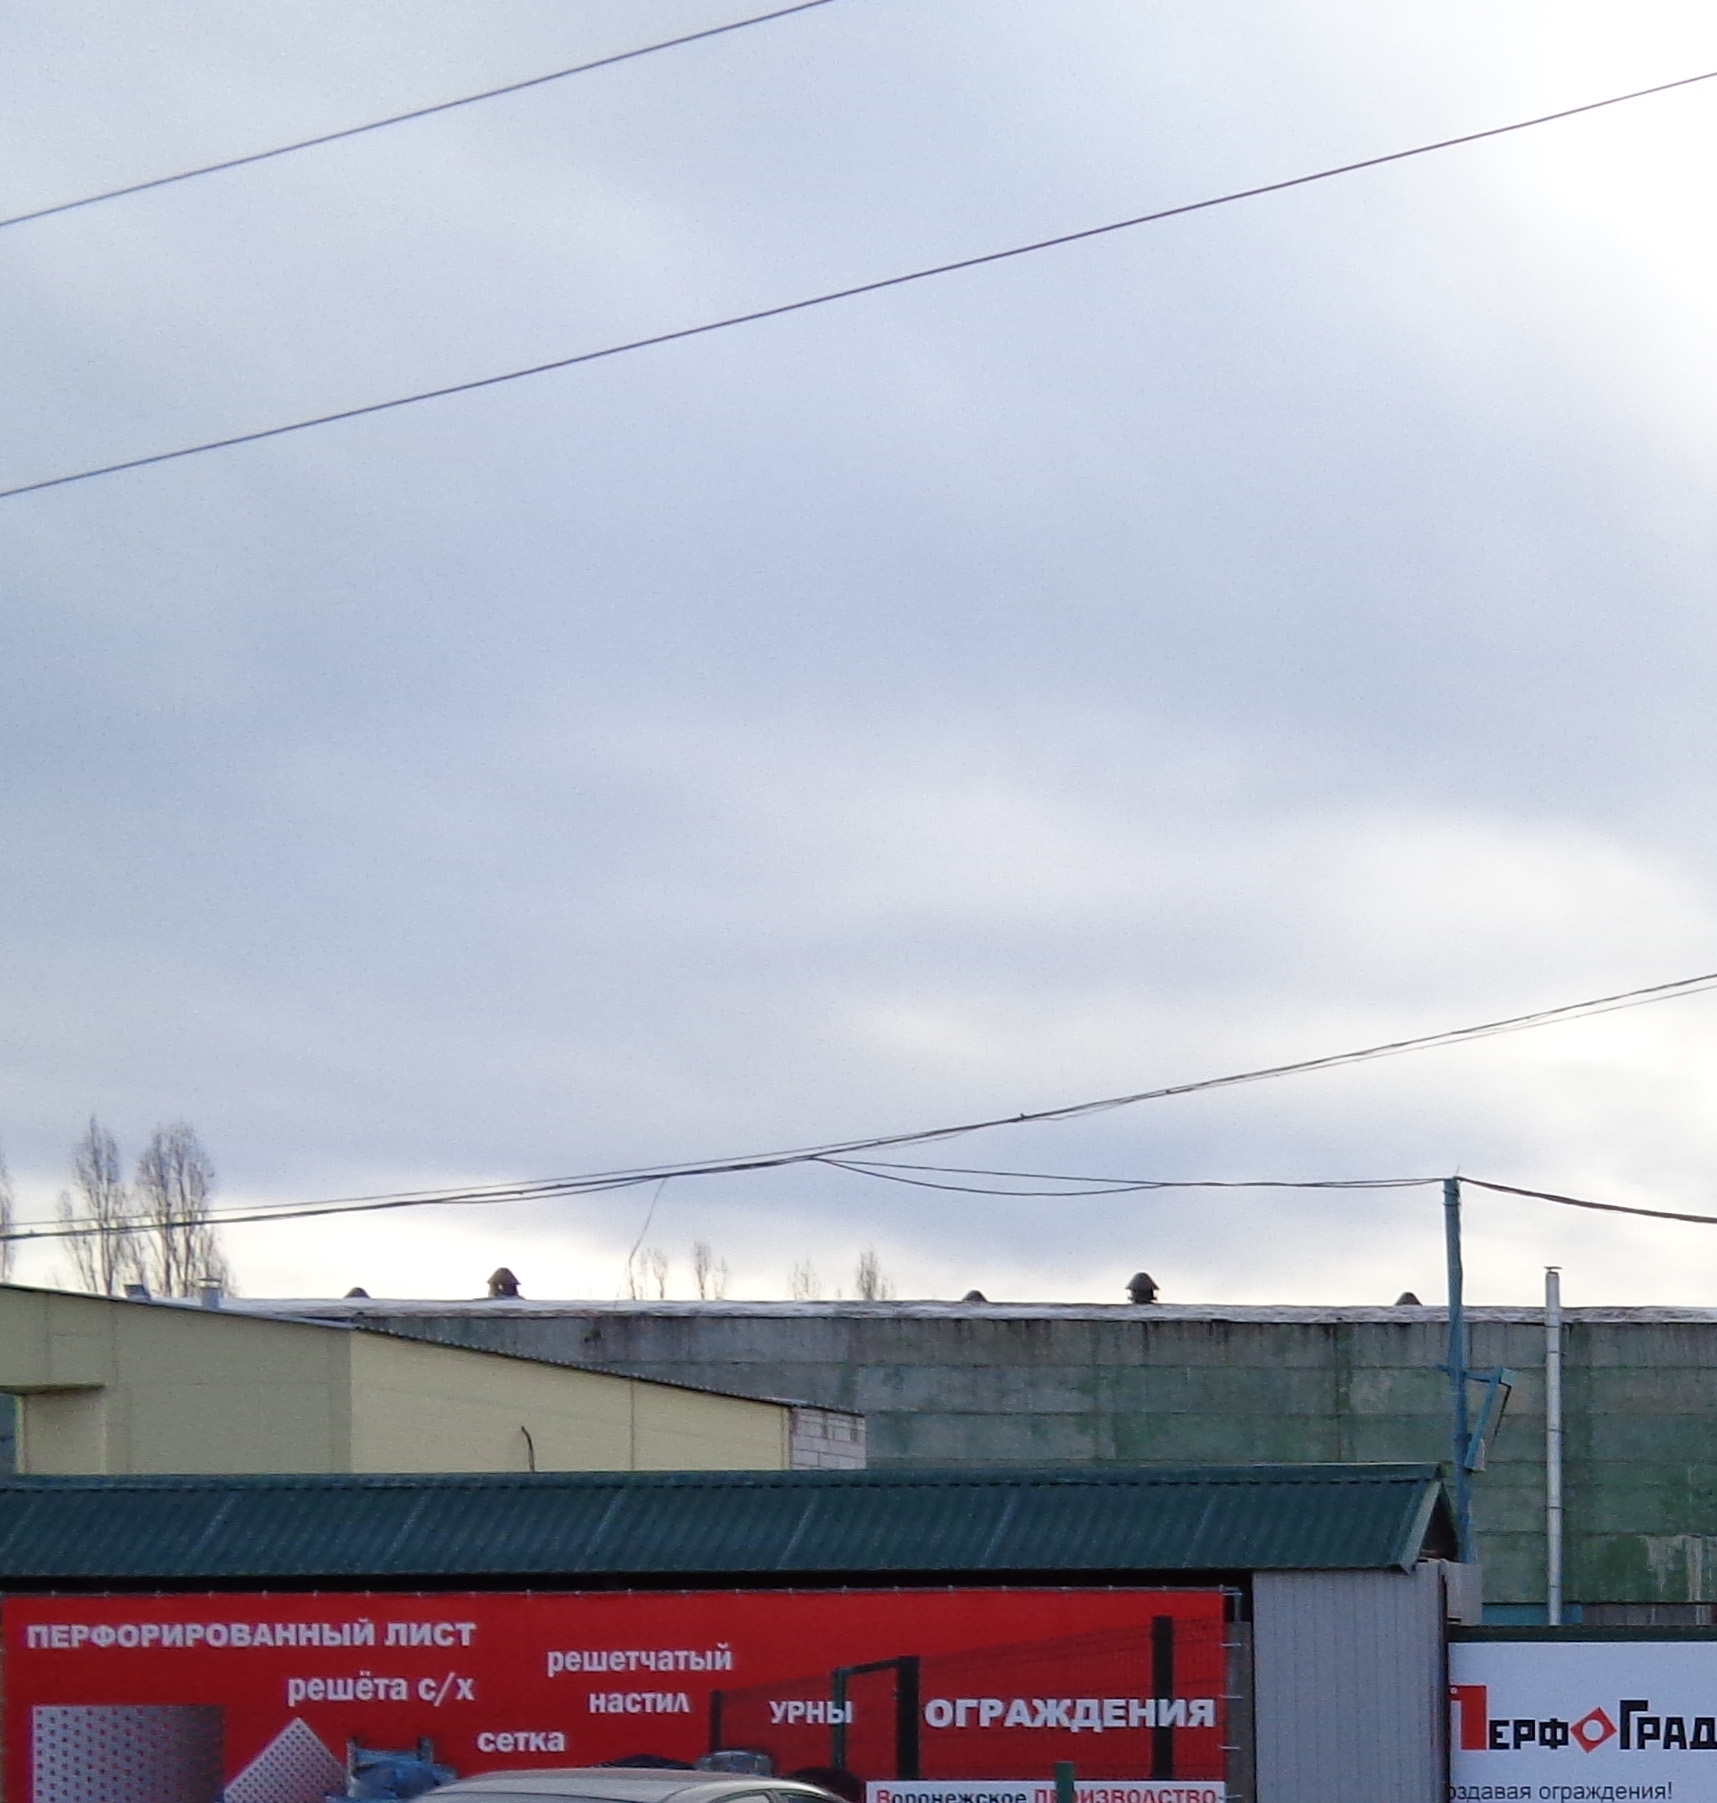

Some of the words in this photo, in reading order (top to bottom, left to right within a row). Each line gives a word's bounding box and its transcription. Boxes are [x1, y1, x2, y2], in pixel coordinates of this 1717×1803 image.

[27, 1617, 375, 1648] ПЕРФОРИРОВАННЫЙ
[385, 1621, 475, 1647] ЛИСТ
[547, 1642, 733, 1678] решетчатый
[288, 1670, 408, 1706] решёта
[418, 1673, 475, 1706] с/х
[589, 1691, 690, 1714] настил
[770, 1701, 853, 1725] УРНЫ
[924, 1699, 1215, 1732] ОГРАЖДЕНИЯ
[477, 1731, 565, 1753] сетка
[1449, 1785, 1531, 1802] оздавая
